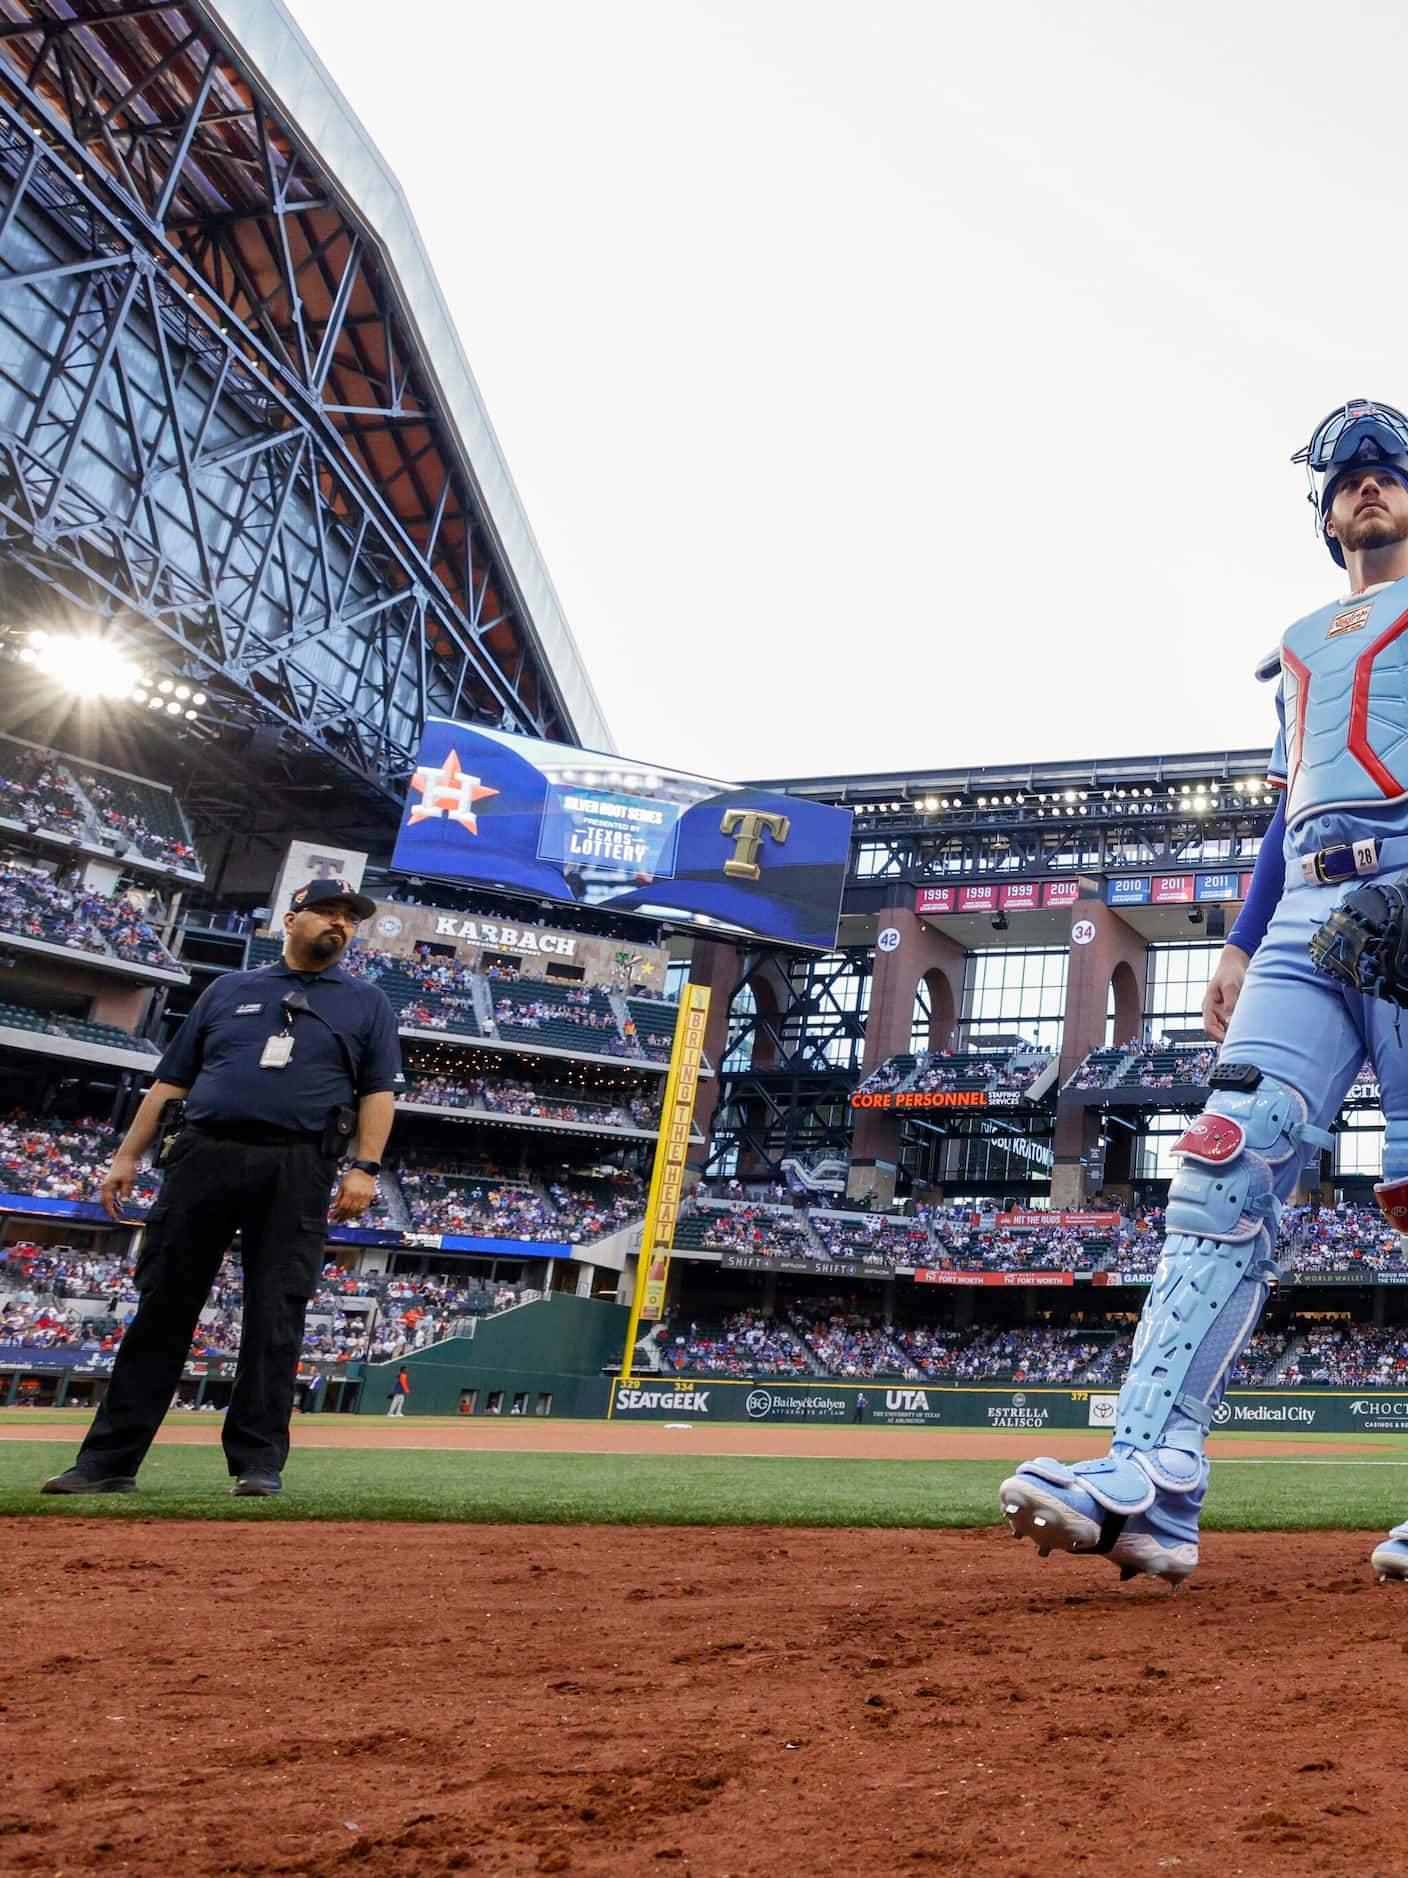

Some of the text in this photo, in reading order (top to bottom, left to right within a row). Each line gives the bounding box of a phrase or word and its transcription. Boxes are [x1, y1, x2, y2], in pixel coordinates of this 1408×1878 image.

[588, 827, 632, 845] TEXAS
[570, 834, 646, 863] LOTTERY
[720, 808, 791, 880] T
[1357, 849, 1373, 865] 28
[1115, 880, 1142, 892] 2010
[1161, 878, 1185, 890] 2011
[1204, 876, 1229, 888] 2011
[924, 889, 949, 900] 1996
[966, 887, 992, 899] 1998
[1007, 885, 1033, 897] 1999
[1050, 883, 1077, 895] 2010
[434, 916, 577, 956] KARBACH
[1075, 925, 1093, 940] 34
[880, 933, 898, 949] 42
[681, 1011, 702, 1101] BRING
[852, 1091, 987, 1107] CORE PERSONNEL
[987, 1091, 1020, 1099] STAFFING
[671, 1108, 688, 1159] THE
[659, 1169, 678, 1240] HEAT
[728, 1257, 761, 1267] SHIFT
[816, 1264, 846, 1274] SHIFT
[958, 1277, 984, 1285] WORTH
[620, 1380, 640, 1389] 329
[674, 1383, 694, 1391] 334
[616, 1389, 710, 1412] SEATGEEK
[886, 1390, 929, 1411] UTA
[1071, 1392, 1088, 1400] 372
[988, 1408, 1049, 1418] ESTRELLA
[1234, 1406, 1315, 1424] Medical City
[992, 1418, 1043, 1427] JALISCO
